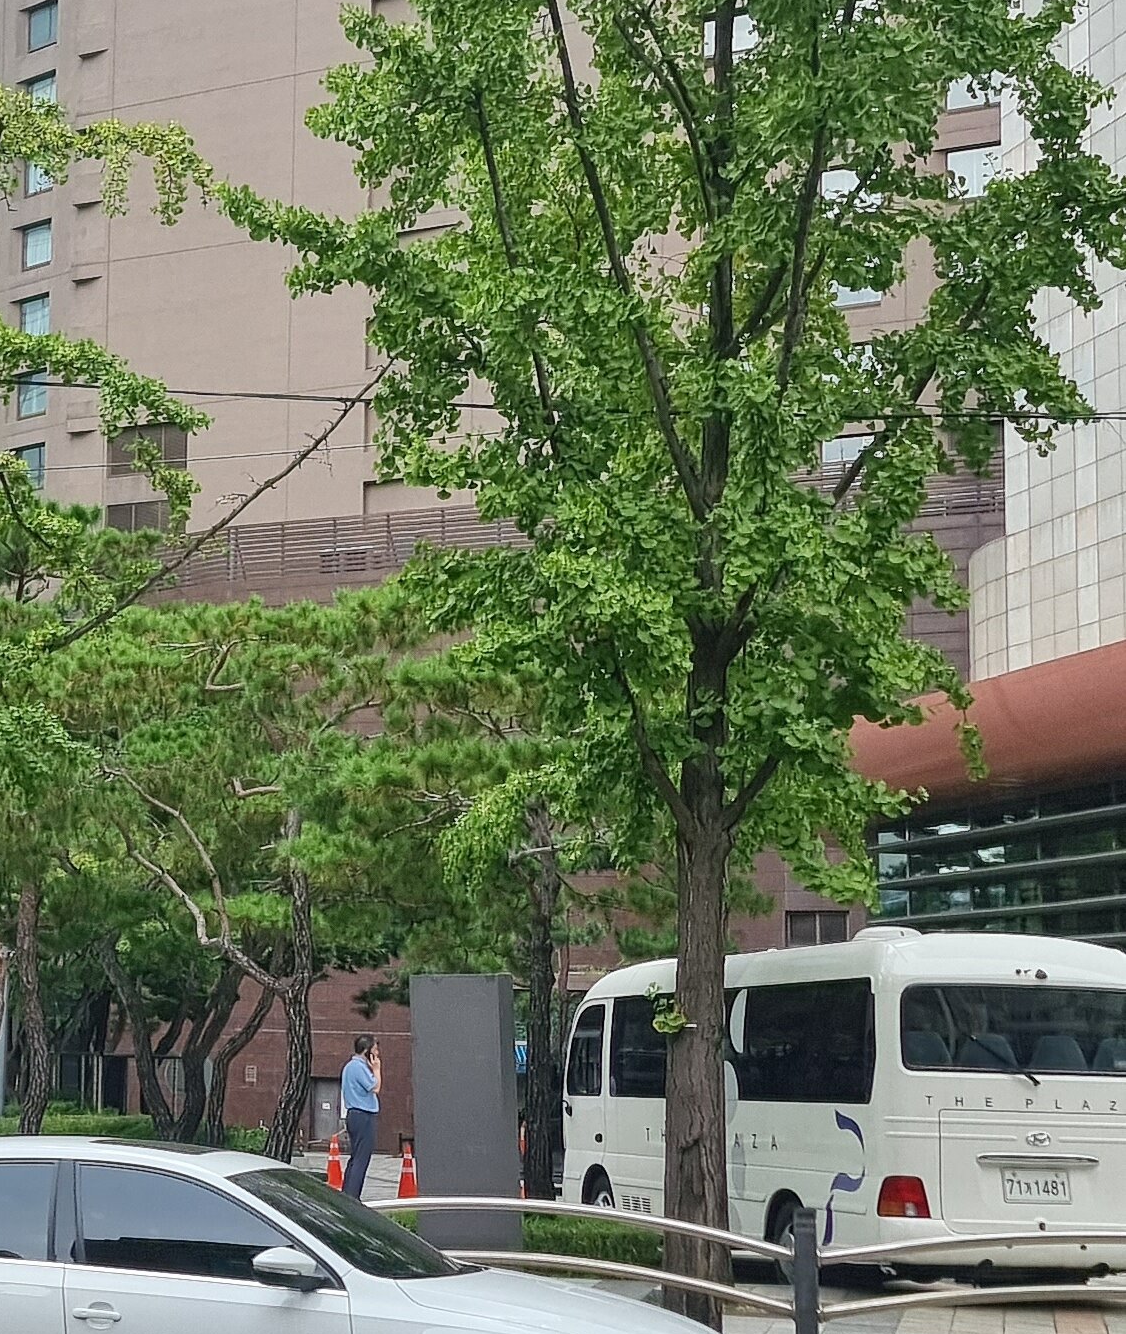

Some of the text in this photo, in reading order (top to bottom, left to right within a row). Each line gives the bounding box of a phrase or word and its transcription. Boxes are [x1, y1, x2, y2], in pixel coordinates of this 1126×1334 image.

[924, 1094, 1119, 1112] THE PLAZ
[733, 1132, 779, 1151] AZA
